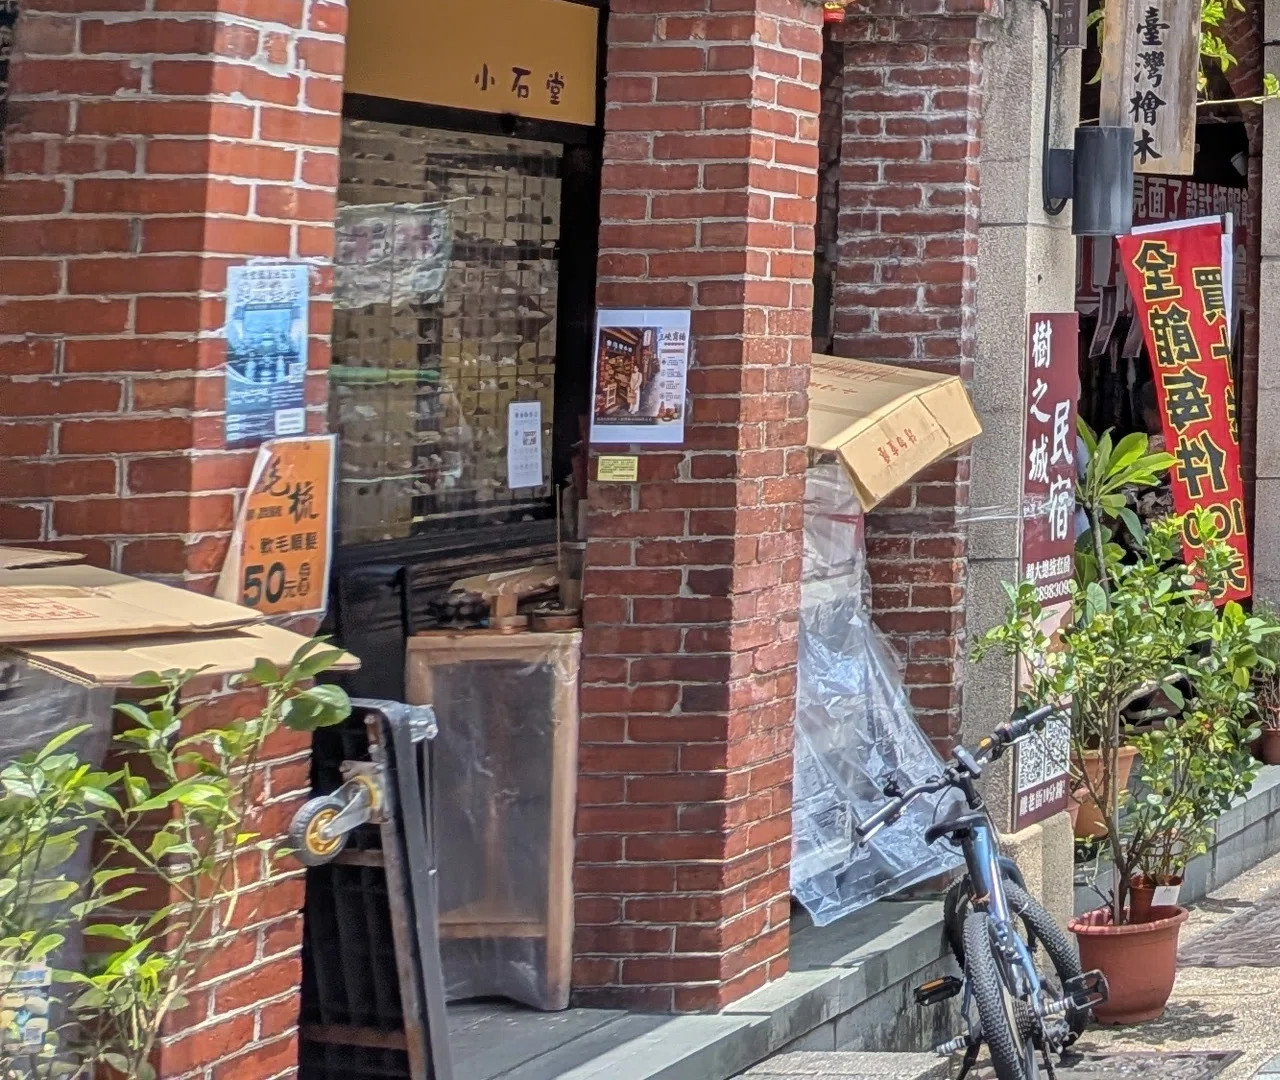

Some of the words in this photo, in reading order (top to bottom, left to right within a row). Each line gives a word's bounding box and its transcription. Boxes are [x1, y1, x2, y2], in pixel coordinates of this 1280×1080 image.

[475, 63, 565, 105] 小石堂
[1049, 399, 1073, 543] 民宿
